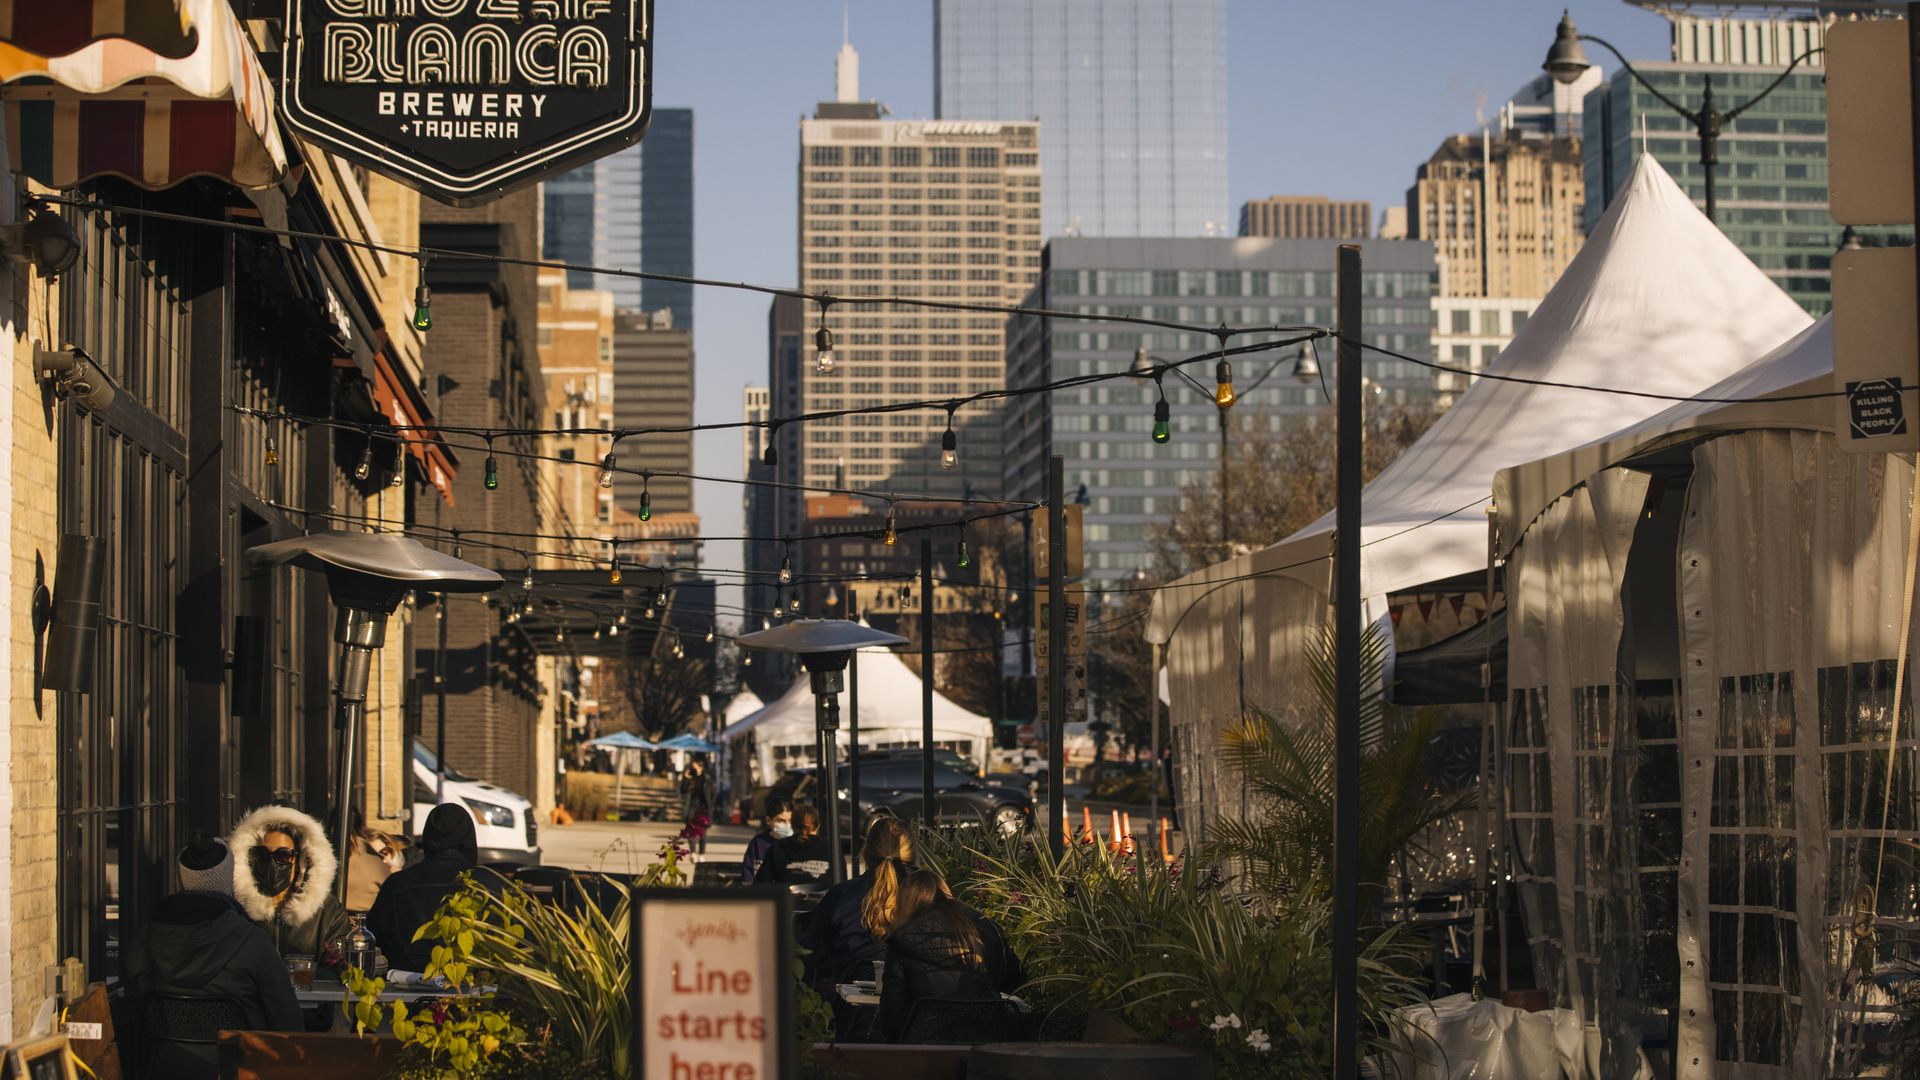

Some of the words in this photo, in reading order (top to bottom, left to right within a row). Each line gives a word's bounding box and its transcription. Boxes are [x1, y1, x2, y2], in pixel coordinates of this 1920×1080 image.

[324, 22, 609, 86] BLANCA
[378, 91, 547, 118] BREWERY
[1856, 395, 1894, 406] KILLING
[1860, 407, 1892, 417] BLACK
[1860, 418, 1896, 428] PEOPLE
[673, 961, 753, 995] Line
[658, 1011, 767, 1041] starts
[671, 1054, 756, 1080] here
